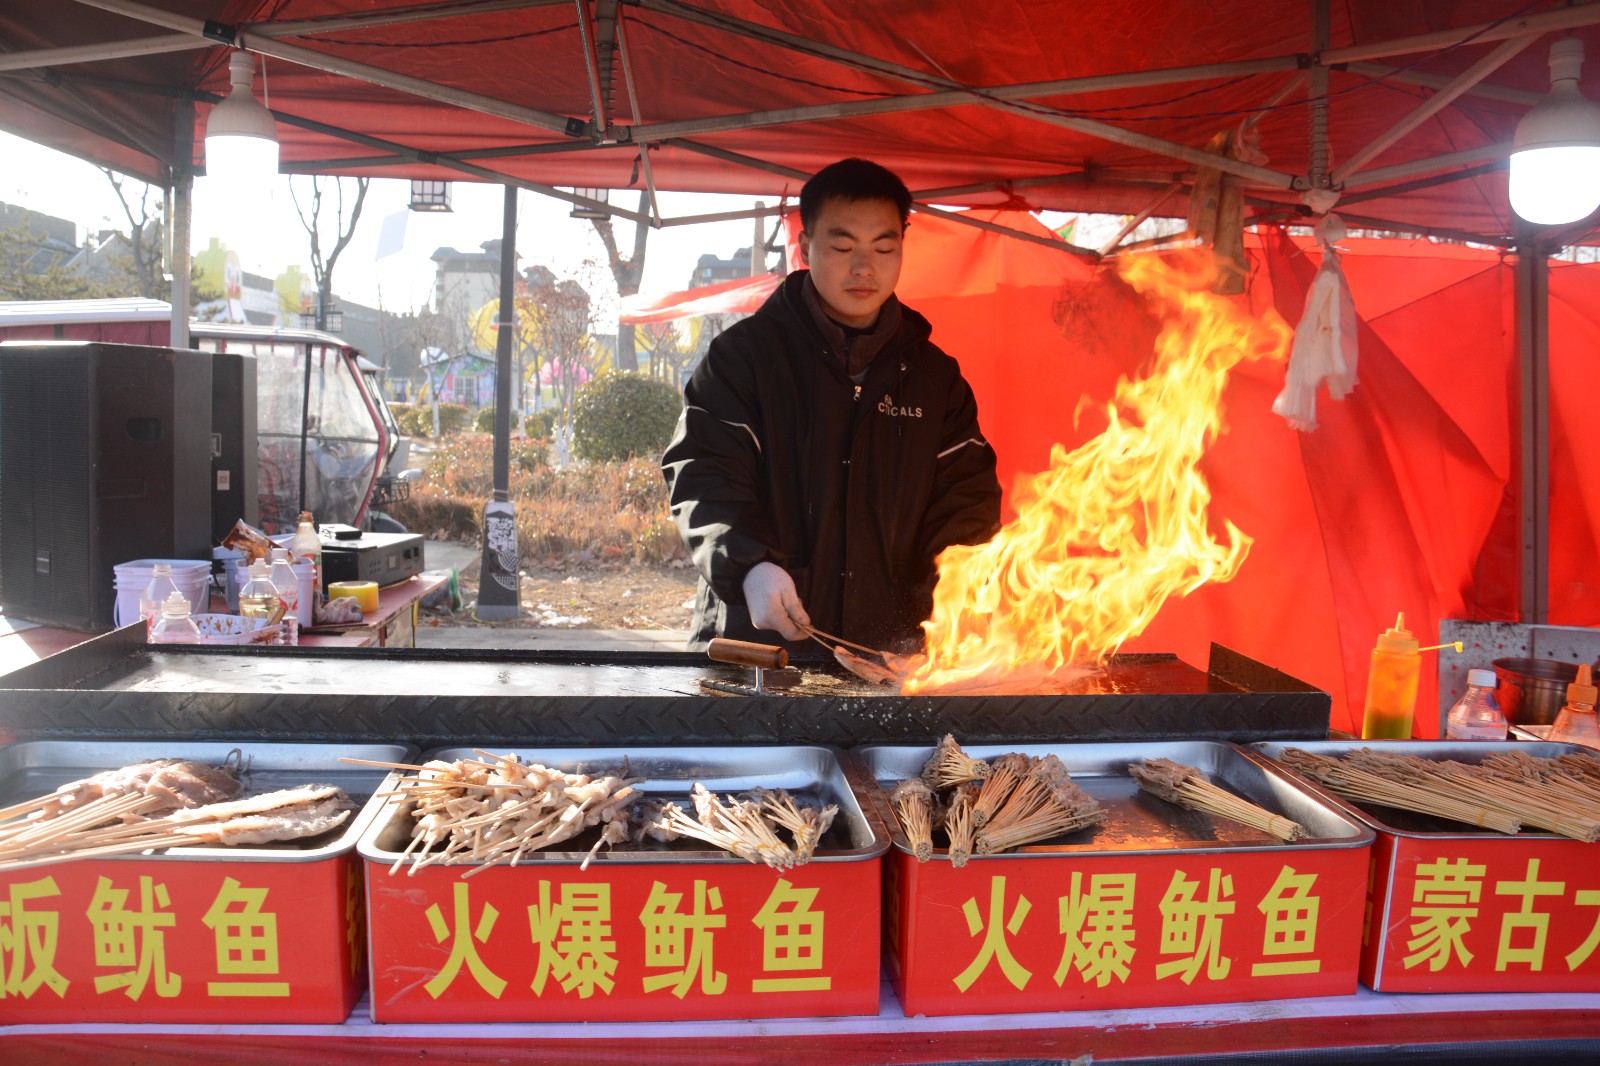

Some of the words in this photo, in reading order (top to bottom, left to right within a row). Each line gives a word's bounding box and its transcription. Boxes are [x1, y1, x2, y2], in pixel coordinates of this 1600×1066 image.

[0, 875, 290, 1001] 板鱿鱼
[423, 878, 831, 999] 火爆鱿鱼
[952, 865, 1321, 993] 火爆鱿鱼
